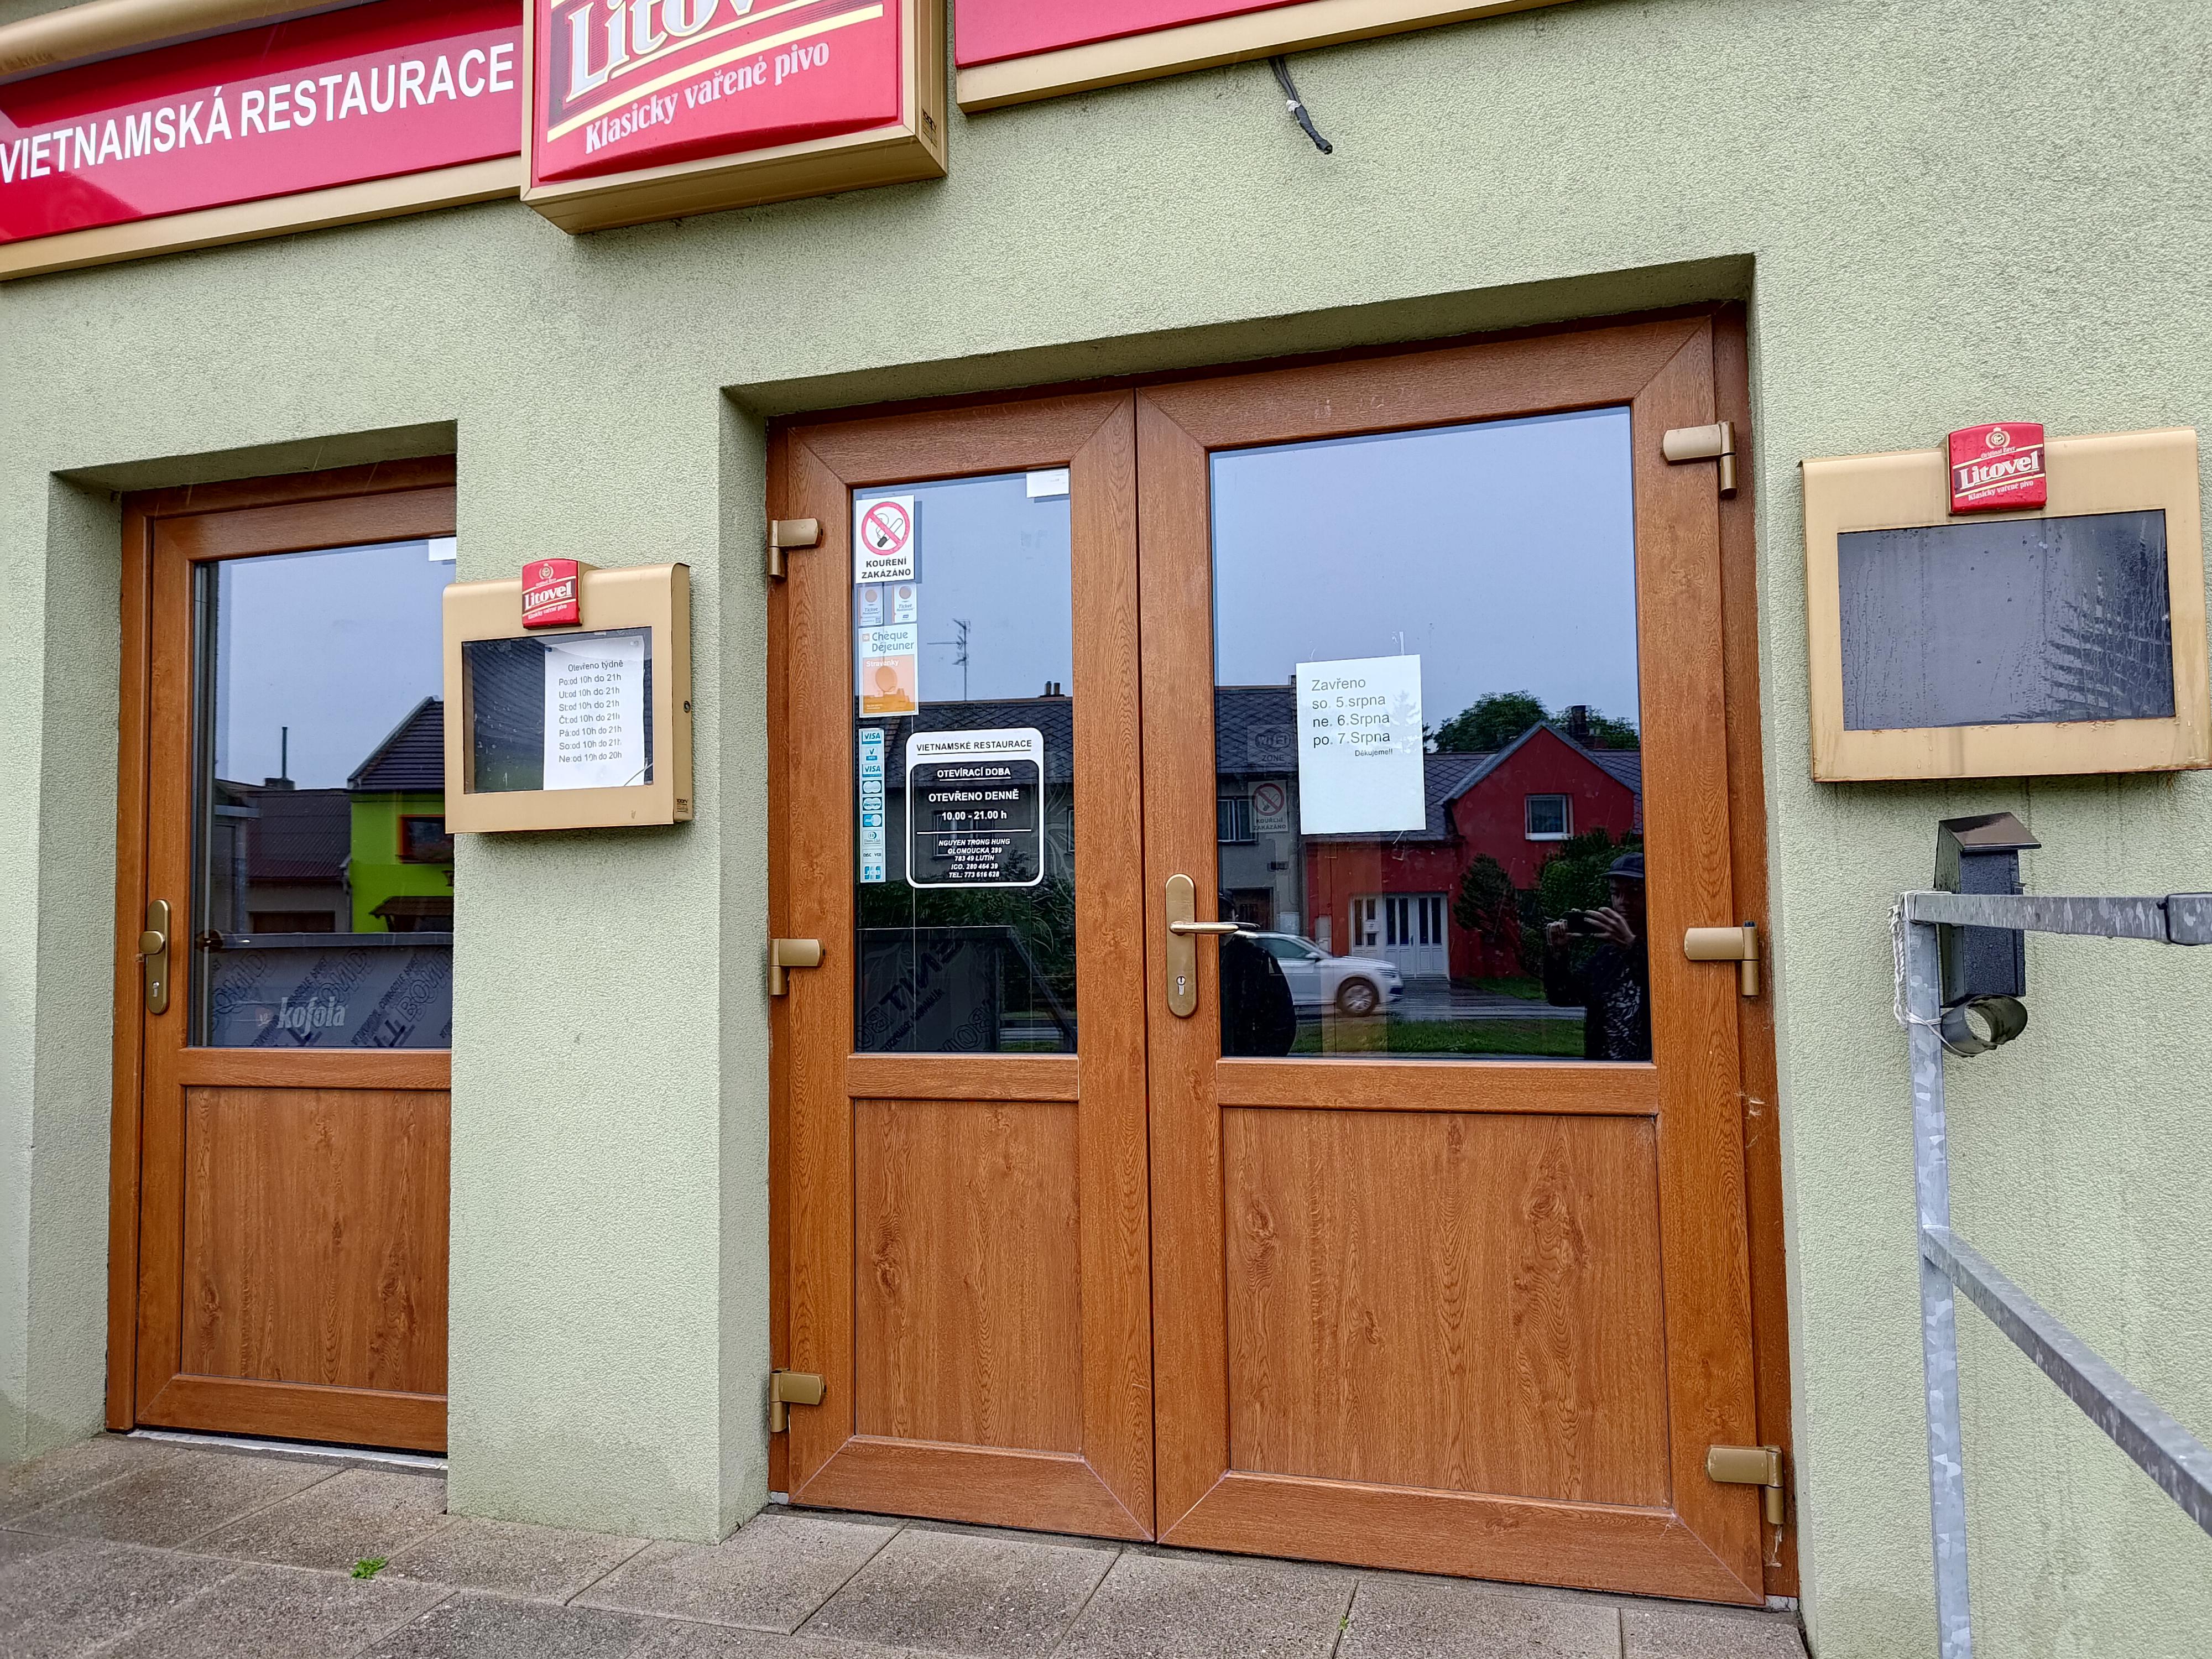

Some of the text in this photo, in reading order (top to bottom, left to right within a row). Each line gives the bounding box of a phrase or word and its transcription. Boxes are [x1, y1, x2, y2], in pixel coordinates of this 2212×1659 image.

[565, 0, 753, 102] Lito
[585, 42, 830, 154] Klasicky vařené pivo
[0, 43, 514, 183] VIETNAMSKÁ RESTAURACE
[1959, 450, 2039, 490] Litovel
[2020, 480, 2034, 489] pivo
[866, 556, 906, 568] KOUŘENÍ
[862, 568, 911, 578] ZAKÁZÁNO
[524, 581, 572, 611] Litovel
[872, 631, 908, 641] Chèque
[872, 641, 915, 653] Déjeuner
[601, 660, 624, 670] týdně
[559, 676, 578, 686] Po:od
[580, 675, 592, 684] 10h
[594, 674, 604, 682] do
[1312, 678, 1366, 691] Zavřeno
[579, 688, 591, 697] 10h
[606, 686, 620, 695] 21h
[559, 702, 577, 712] St:od
[579, 701, 592, 709] 10h
[606, 700, 619, 708] 21h
[559, 714, 578, 724] Čt:od
[580, 714, 593, 722] 10h
[607, 712, 620, 721] 21h
[1313, 718, 1333, 727] ne.
[559, 728, 580, 737] Pá:od
[582, 727, 596, 735] 10h
[608, 725, 622, 733] 21h
[559, 741, 580, 750] So:od
[608, 738, 622, 747] 21h
[916, 740, 1032, 752] VIETNAMSKÉ RESTAURACE
[1313, 736, 1333, 748] po.
[559, 754, 582, 763] Ne:od
[585, 753, 597, 761] 10h
[608, 751, 622, 759] 20h
[937, 766, 1011, 778] OTEVÍRACÍ DOBA
[928, 789, 1019, 802] OTEVŘENO DENNĚ
[941, 811, 966, 821] 10.00
[973, 811, 999, 820] 21.00
[1000, 810, 1007, 819] h
[277, 996, 346, 1037] kofola
